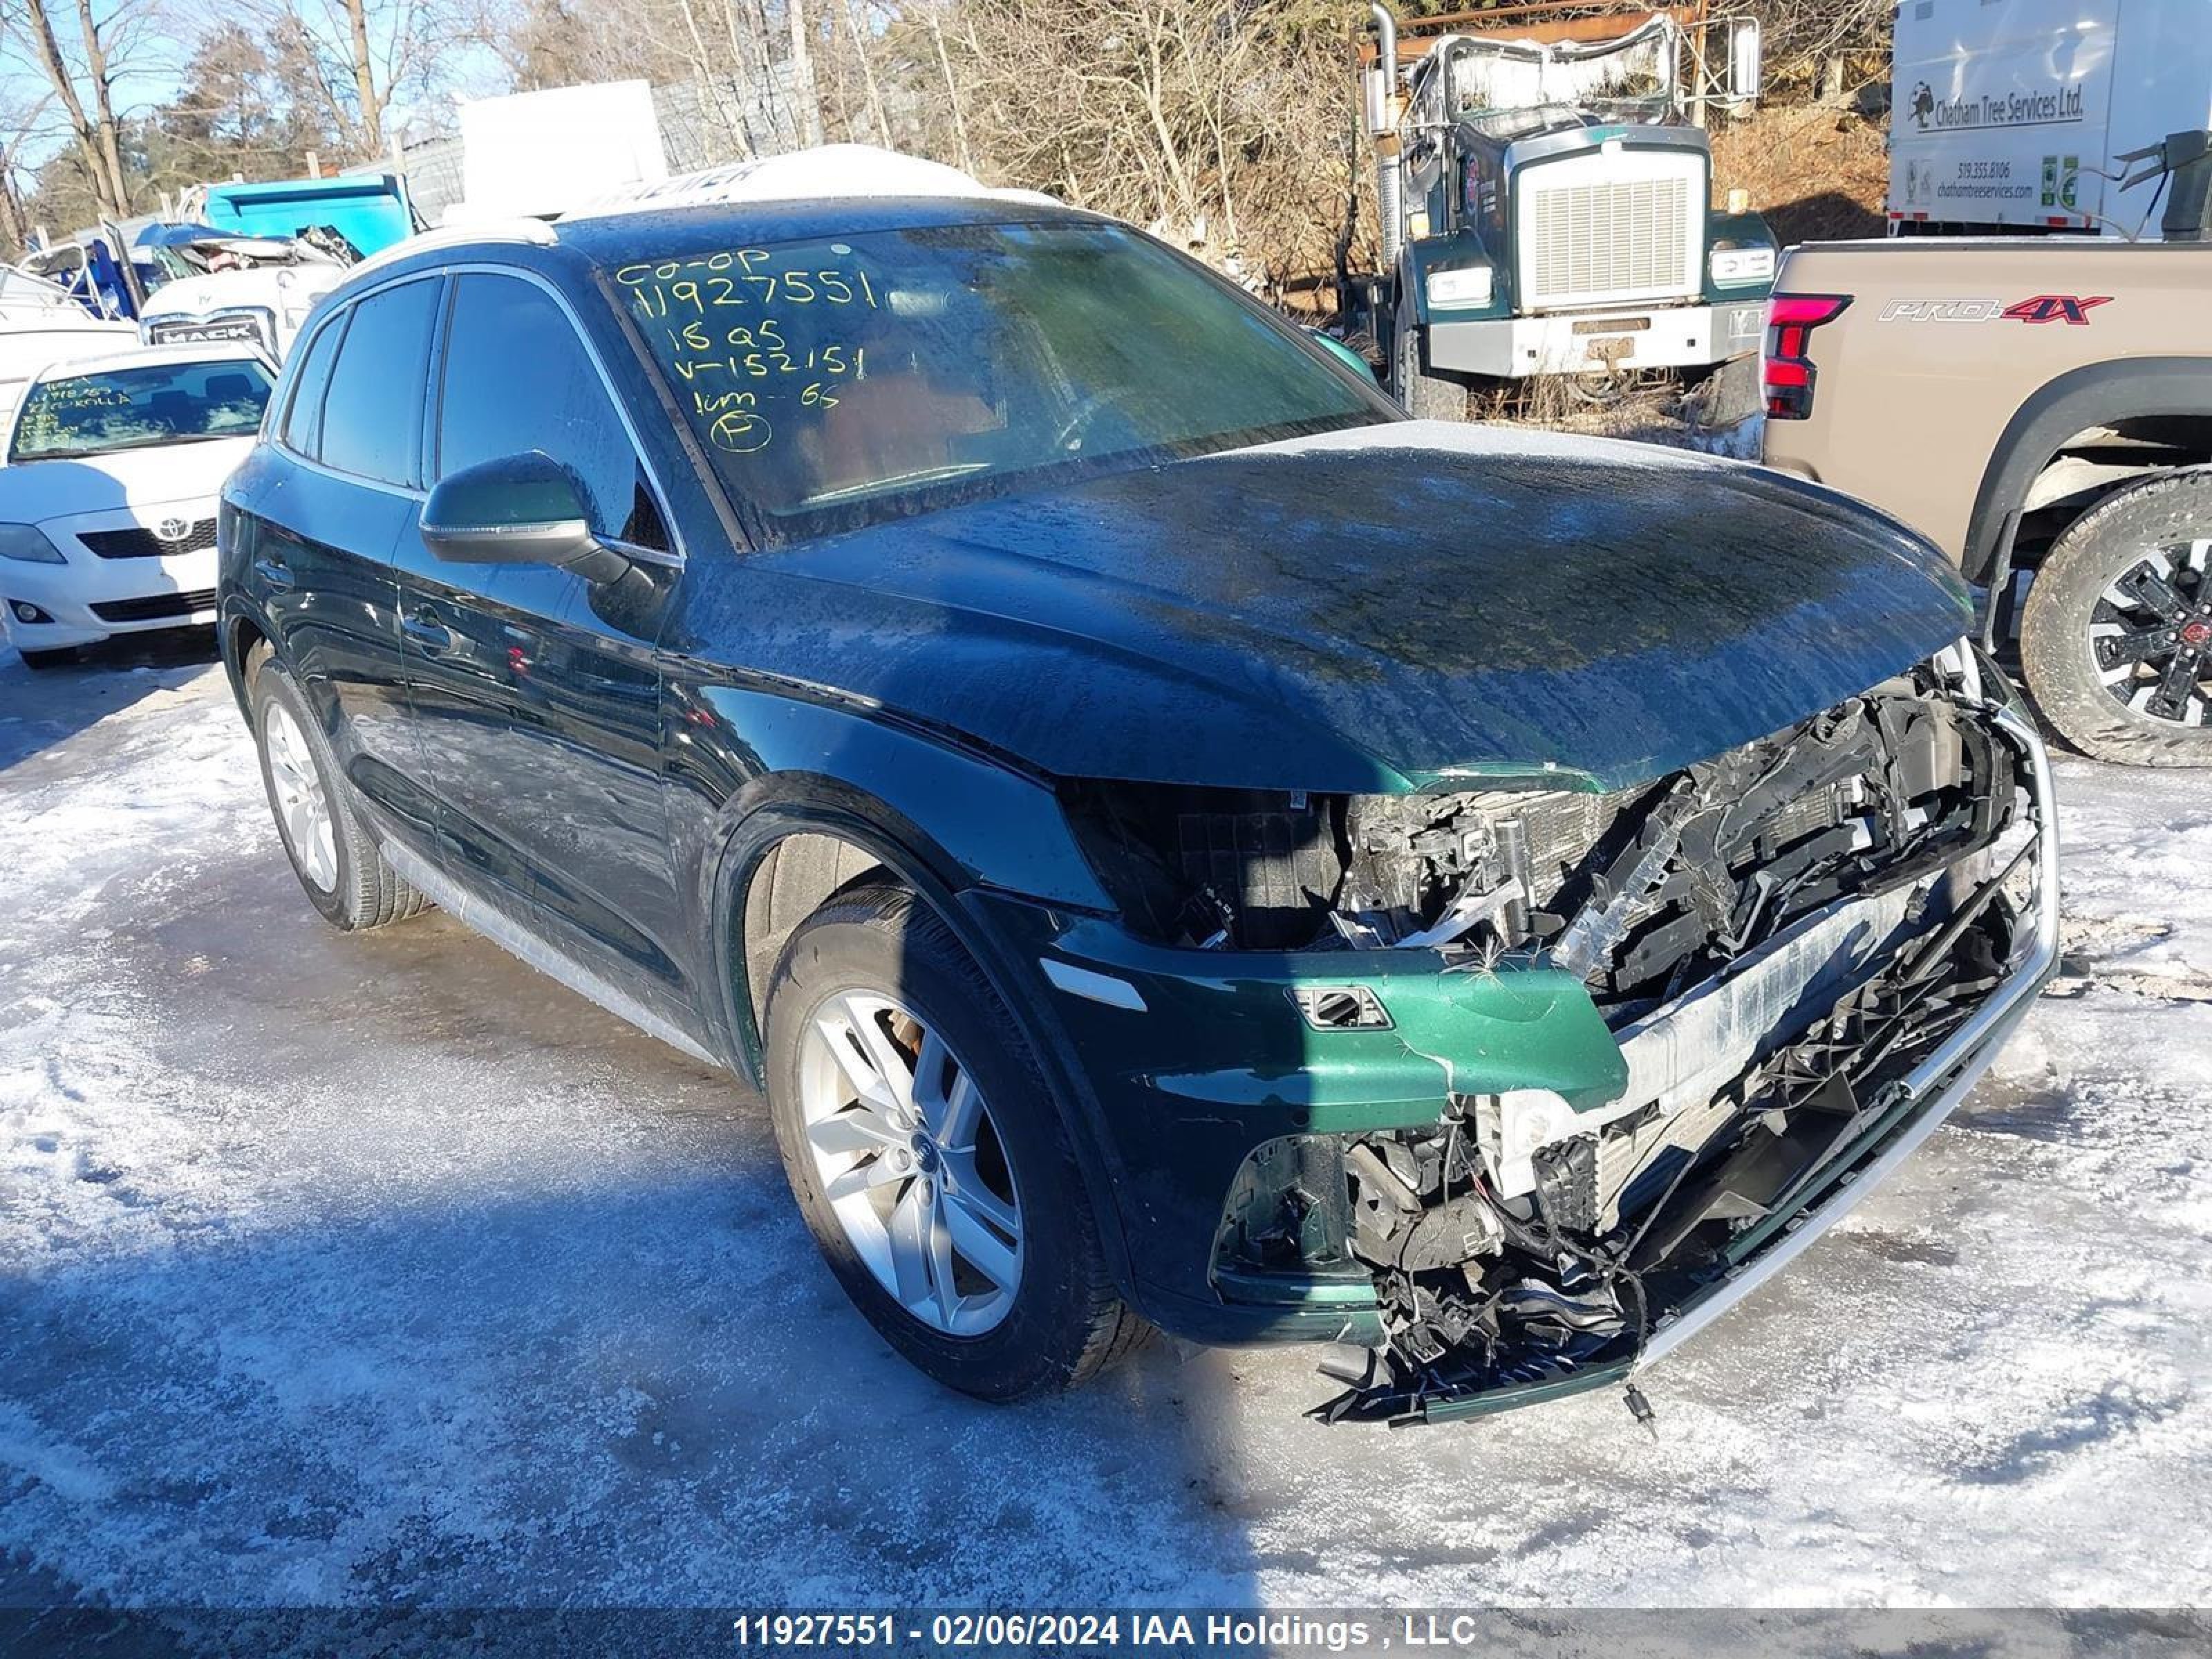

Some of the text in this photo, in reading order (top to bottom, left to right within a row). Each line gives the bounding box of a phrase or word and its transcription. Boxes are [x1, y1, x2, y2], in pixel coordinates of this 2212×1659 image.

[1936, 82, 2083, 126] Chatham Tree Services Ltd.
[1937, 180, 2033, 199] chathamtreeservices.com
[633, 270, 878, 318] 11927551
[162, 325, 252, 344] MACK
